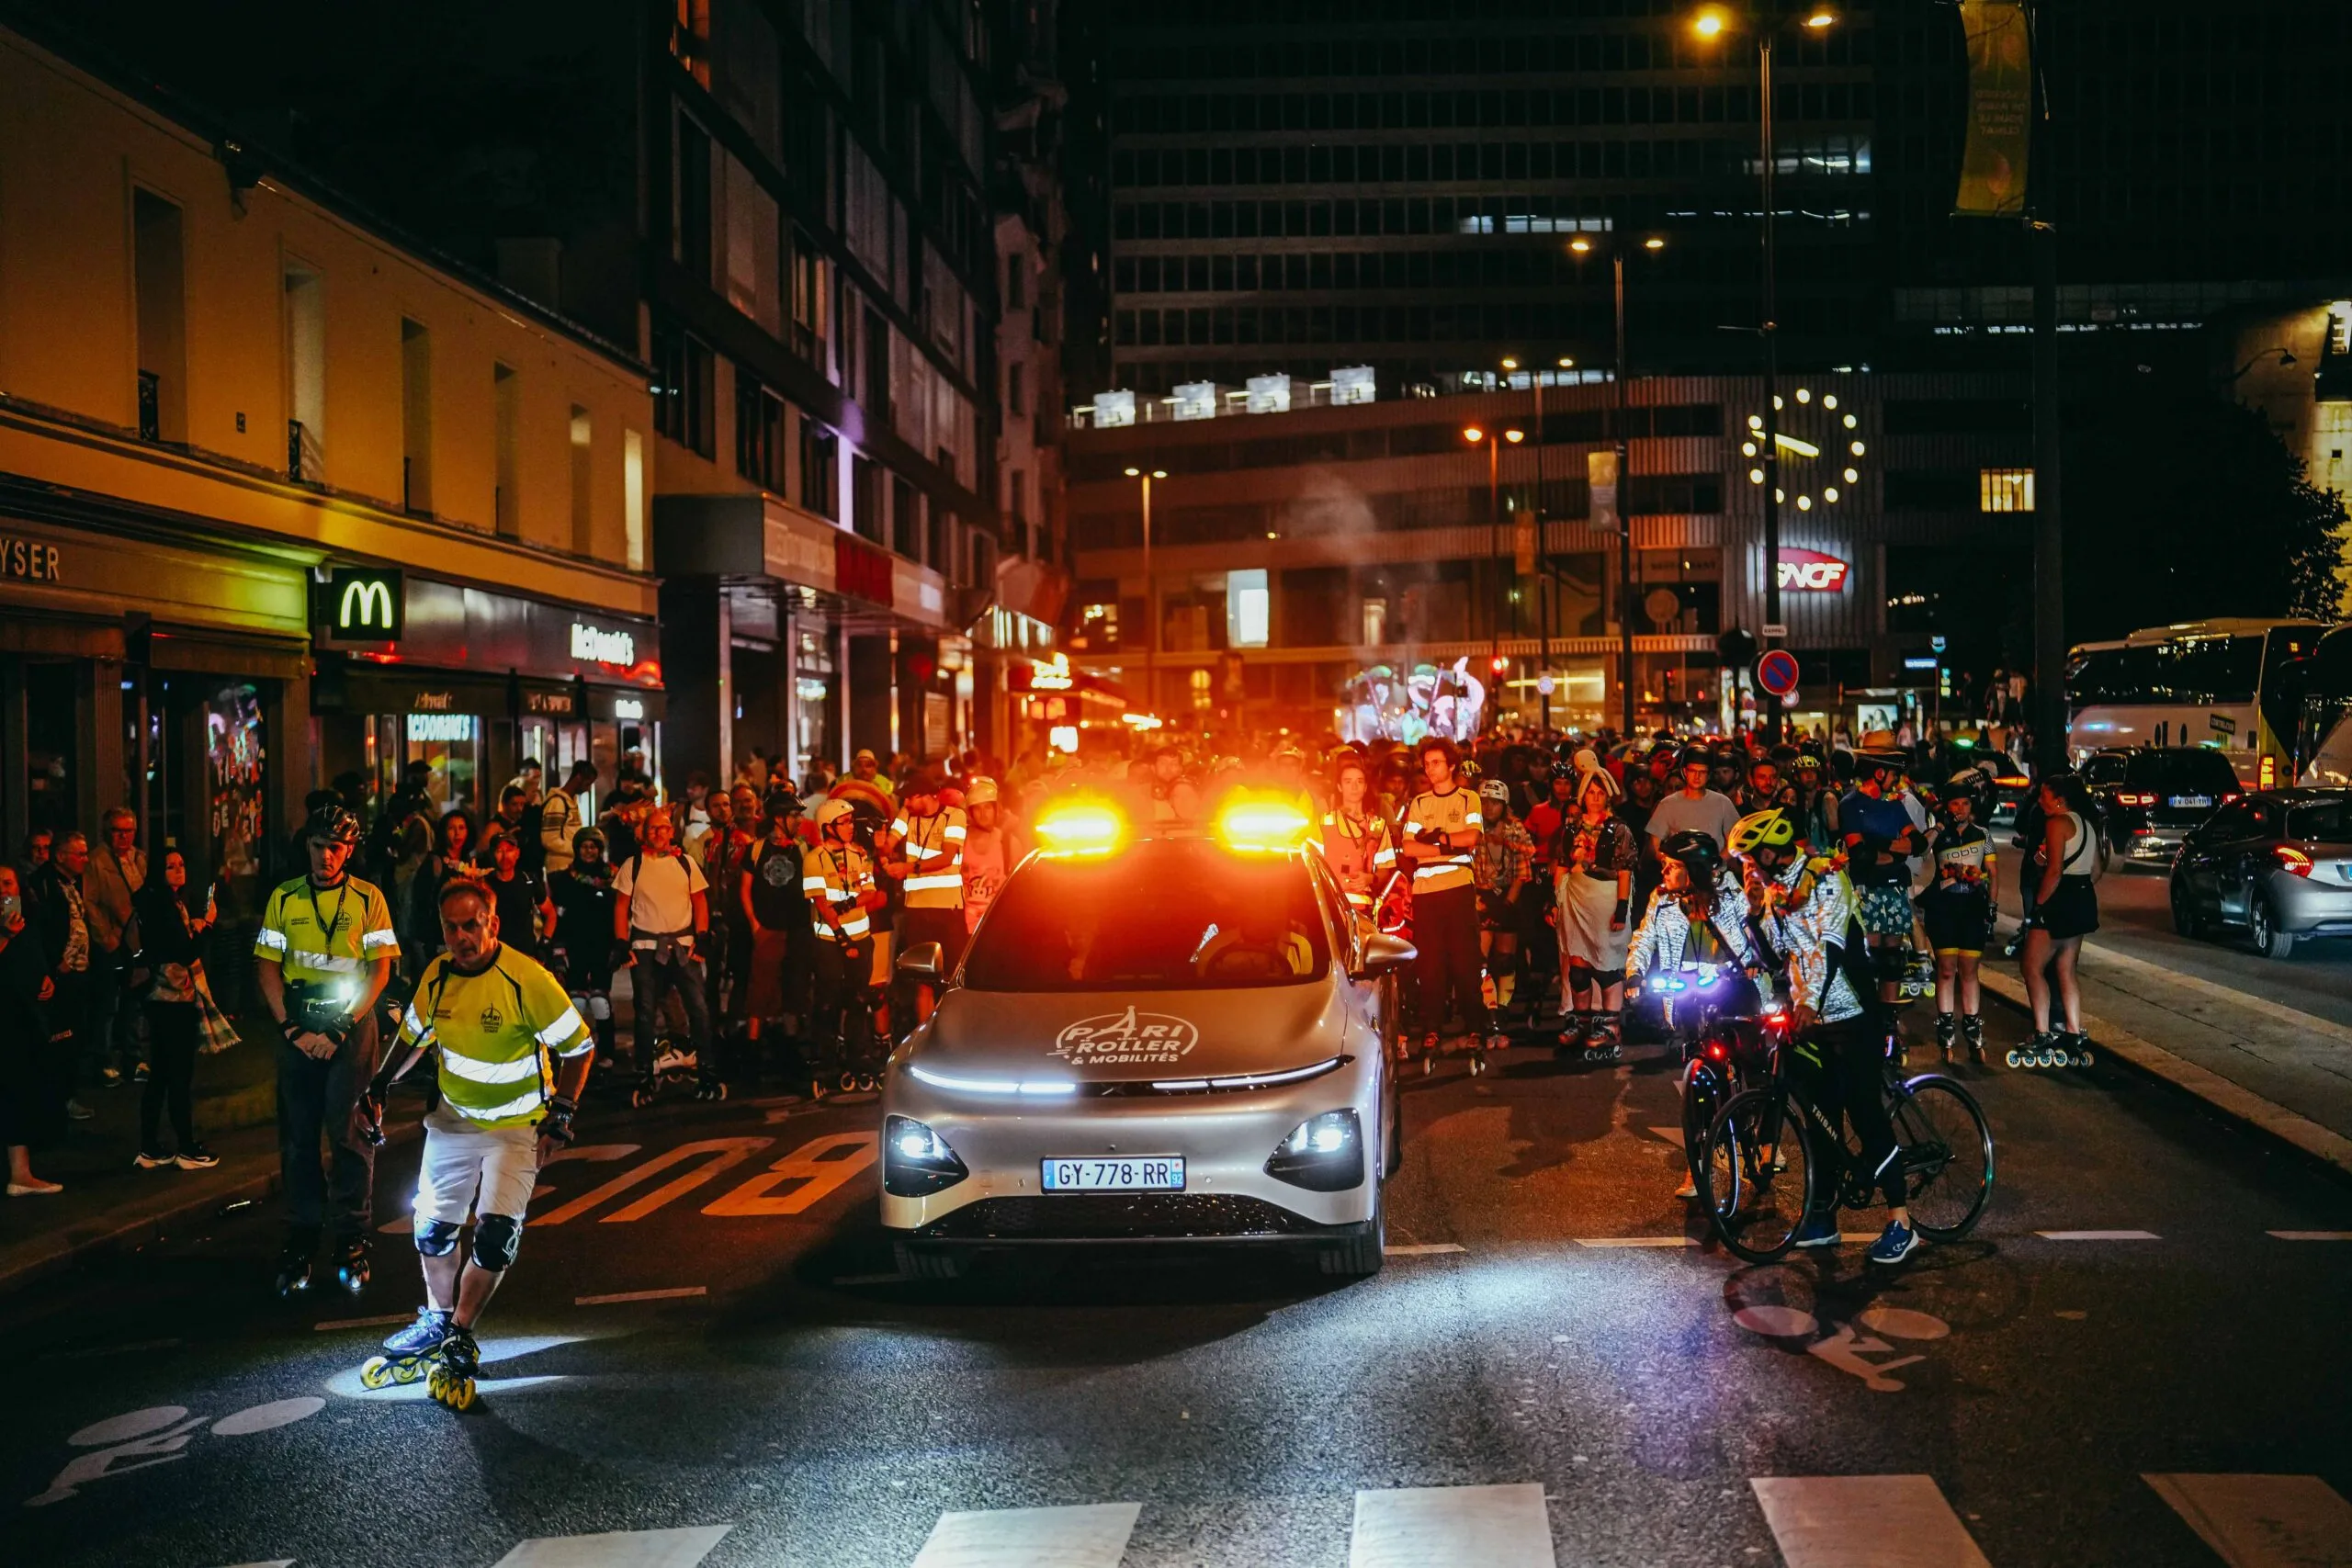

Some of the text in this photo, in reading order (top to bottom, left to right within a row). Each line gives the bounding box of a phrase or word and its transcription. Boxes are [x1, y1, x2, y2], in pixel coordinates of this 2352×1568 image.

[0, 538, 60, 581] YSER
[1065, 1005, 1185, 1041] PARI
[1076, 1041, 1182, 1054] ROLLER
[1071, 1053, 1179, 1065] & MOBILITÉS
[1058, 1163, 1169, 1185] GY-778-RR
